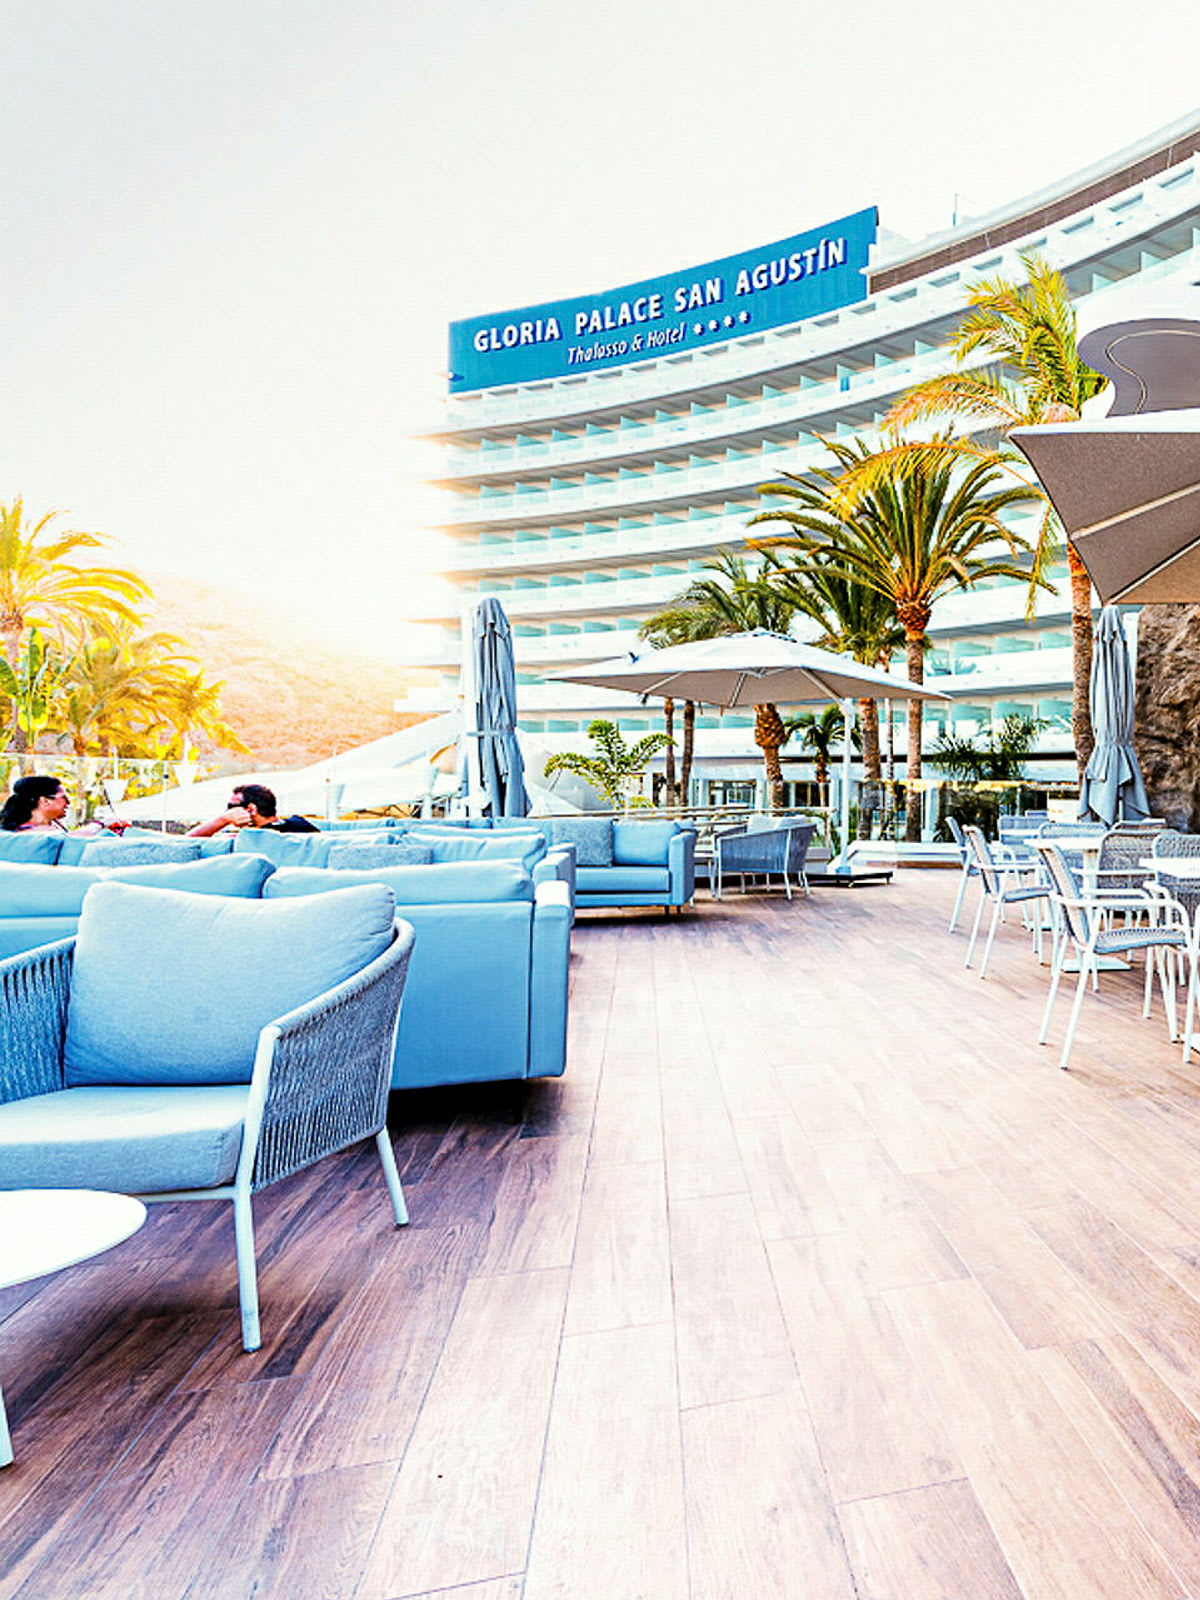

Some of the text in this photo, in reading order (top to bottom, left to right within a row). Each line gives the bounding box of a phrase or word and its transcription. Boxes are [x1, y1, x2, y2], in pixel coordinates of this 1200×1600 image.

[473, 237, 847, 352] GLORIA PALACE SAN AGUSTÍN
[567, 322, 687, 364] Thalasso & Hotel
